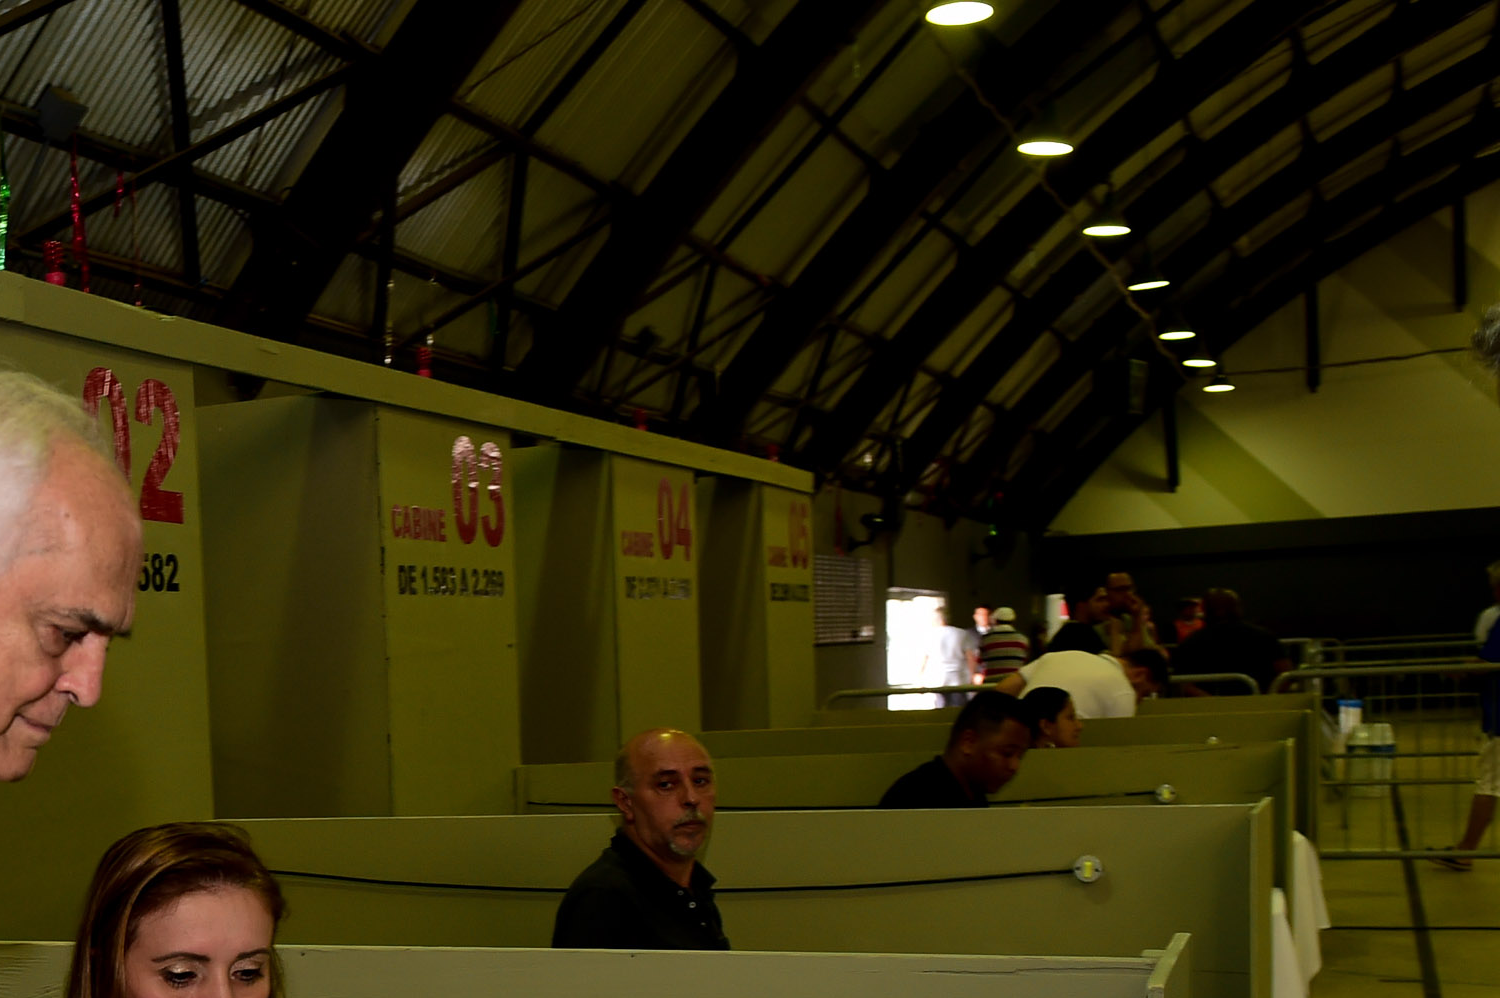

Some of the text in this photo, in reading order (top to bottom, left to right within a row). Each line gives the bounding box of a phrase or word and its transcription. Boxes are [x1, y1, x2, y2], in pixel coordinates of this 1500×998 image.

[83, 367, 184, 524] 02
[391, 435, 505, 547] CABINE 03
[657, 477, 692, 561] 04
[398, 565, 418, 595] DE
[460, 567, 470, 596] A
